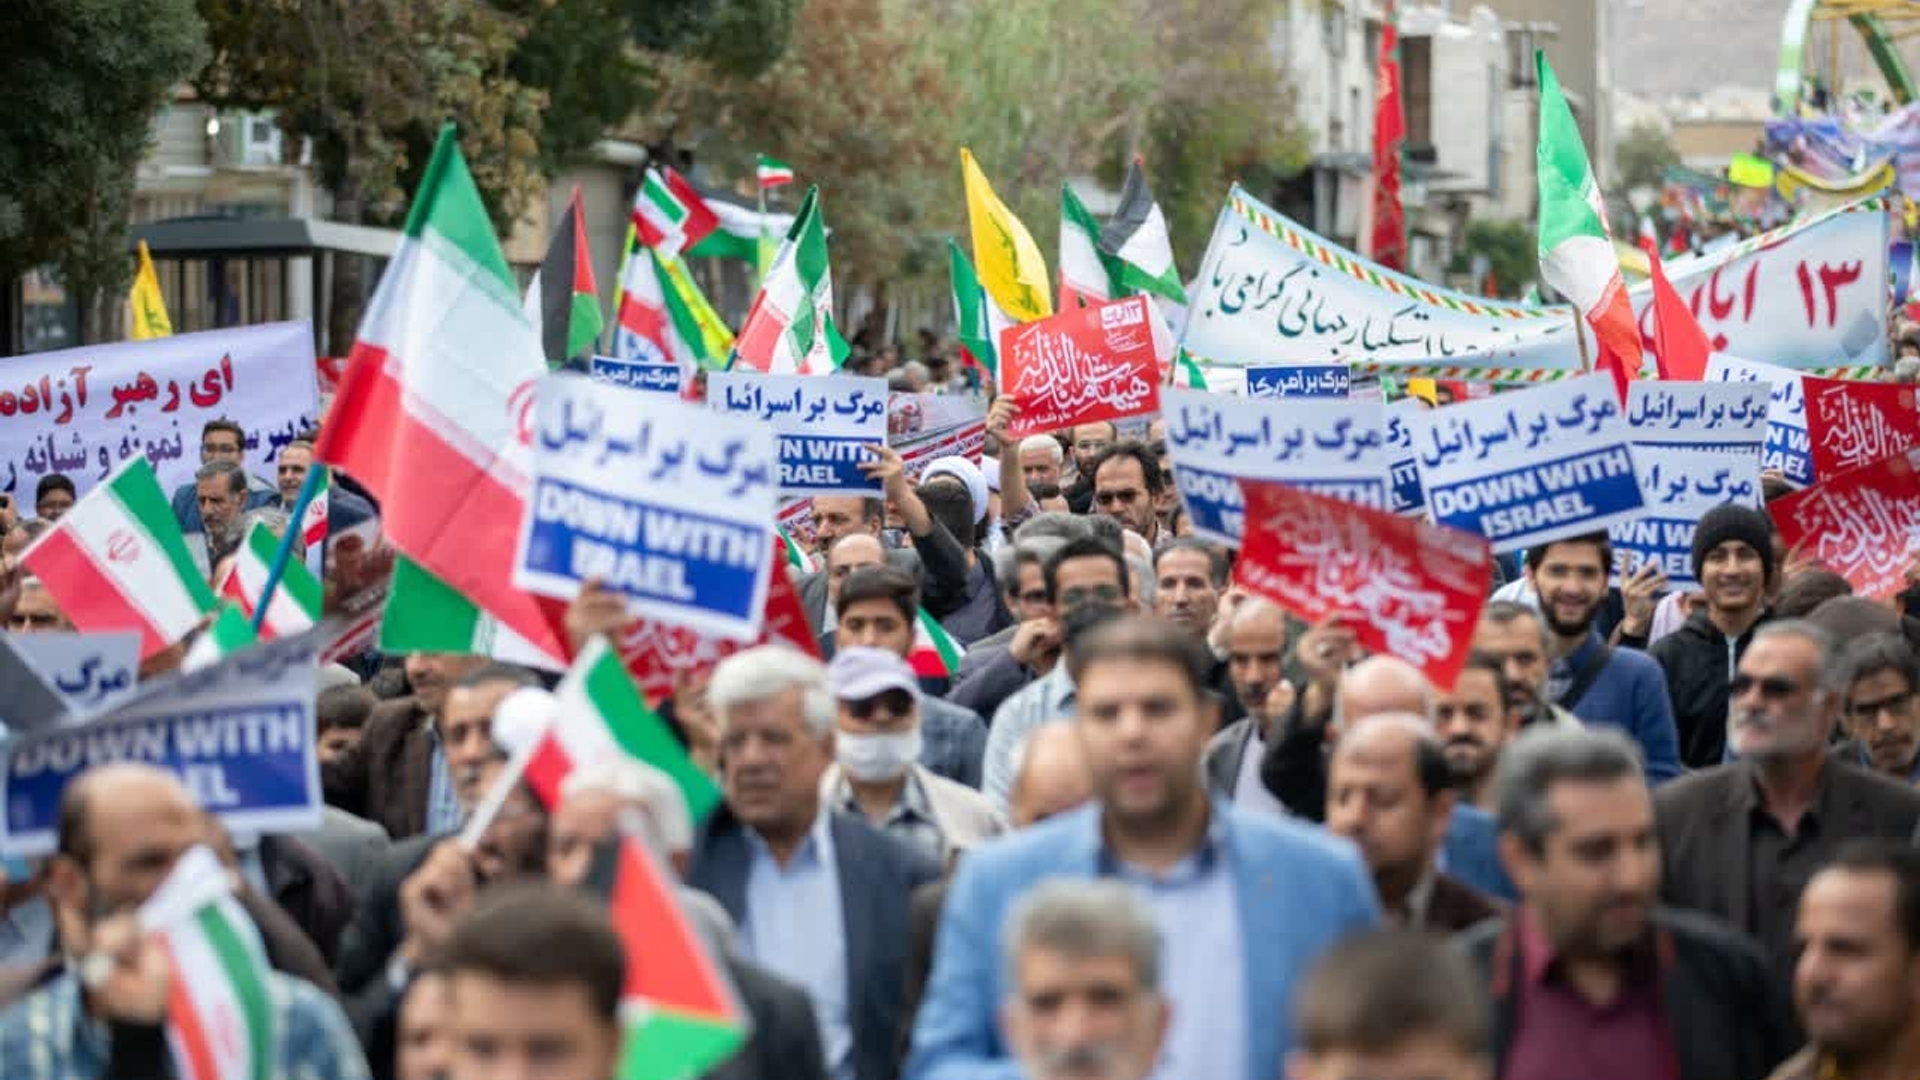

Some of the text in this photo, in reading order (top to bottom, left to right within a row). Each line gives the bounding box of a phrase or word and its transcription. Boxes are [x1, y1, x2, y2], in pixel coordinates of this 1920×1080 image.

[1219, 259, 1308, 315] گرامی
[1277, 268, 1347, 355] جهانی
[105, 370, 181, 418] رهبر
[190, 353, 234, 408] ای
[1249, 369, 1348, 396] مرگ بر آمریکا
[803, 397, 827, 422] بر
[833, 389, 884, 424] مرگ
[1422, 392, 1616, 468] مرگ بر اسرائیل
[1629, 391, 1767, 429] مرگ بر اسرائیل
[1170, 406, 1382, 462] مرگ بر اسرائیل
[780, 464, 841, 484] RAEL
[1433, 470, 1538, 518] DOWN
[1537, 448, 1629, 496] WITH
[1660, 474, 1688, 503] بر
[1694, 468, 1753, 504] مرگ
[539, 483, 759, 572] DOWN WITH
[1479, 491, 1595, 538] ISRAEL
[55, 657, 131, 706] مرگ
[174, 707, 302, 758] WITH
